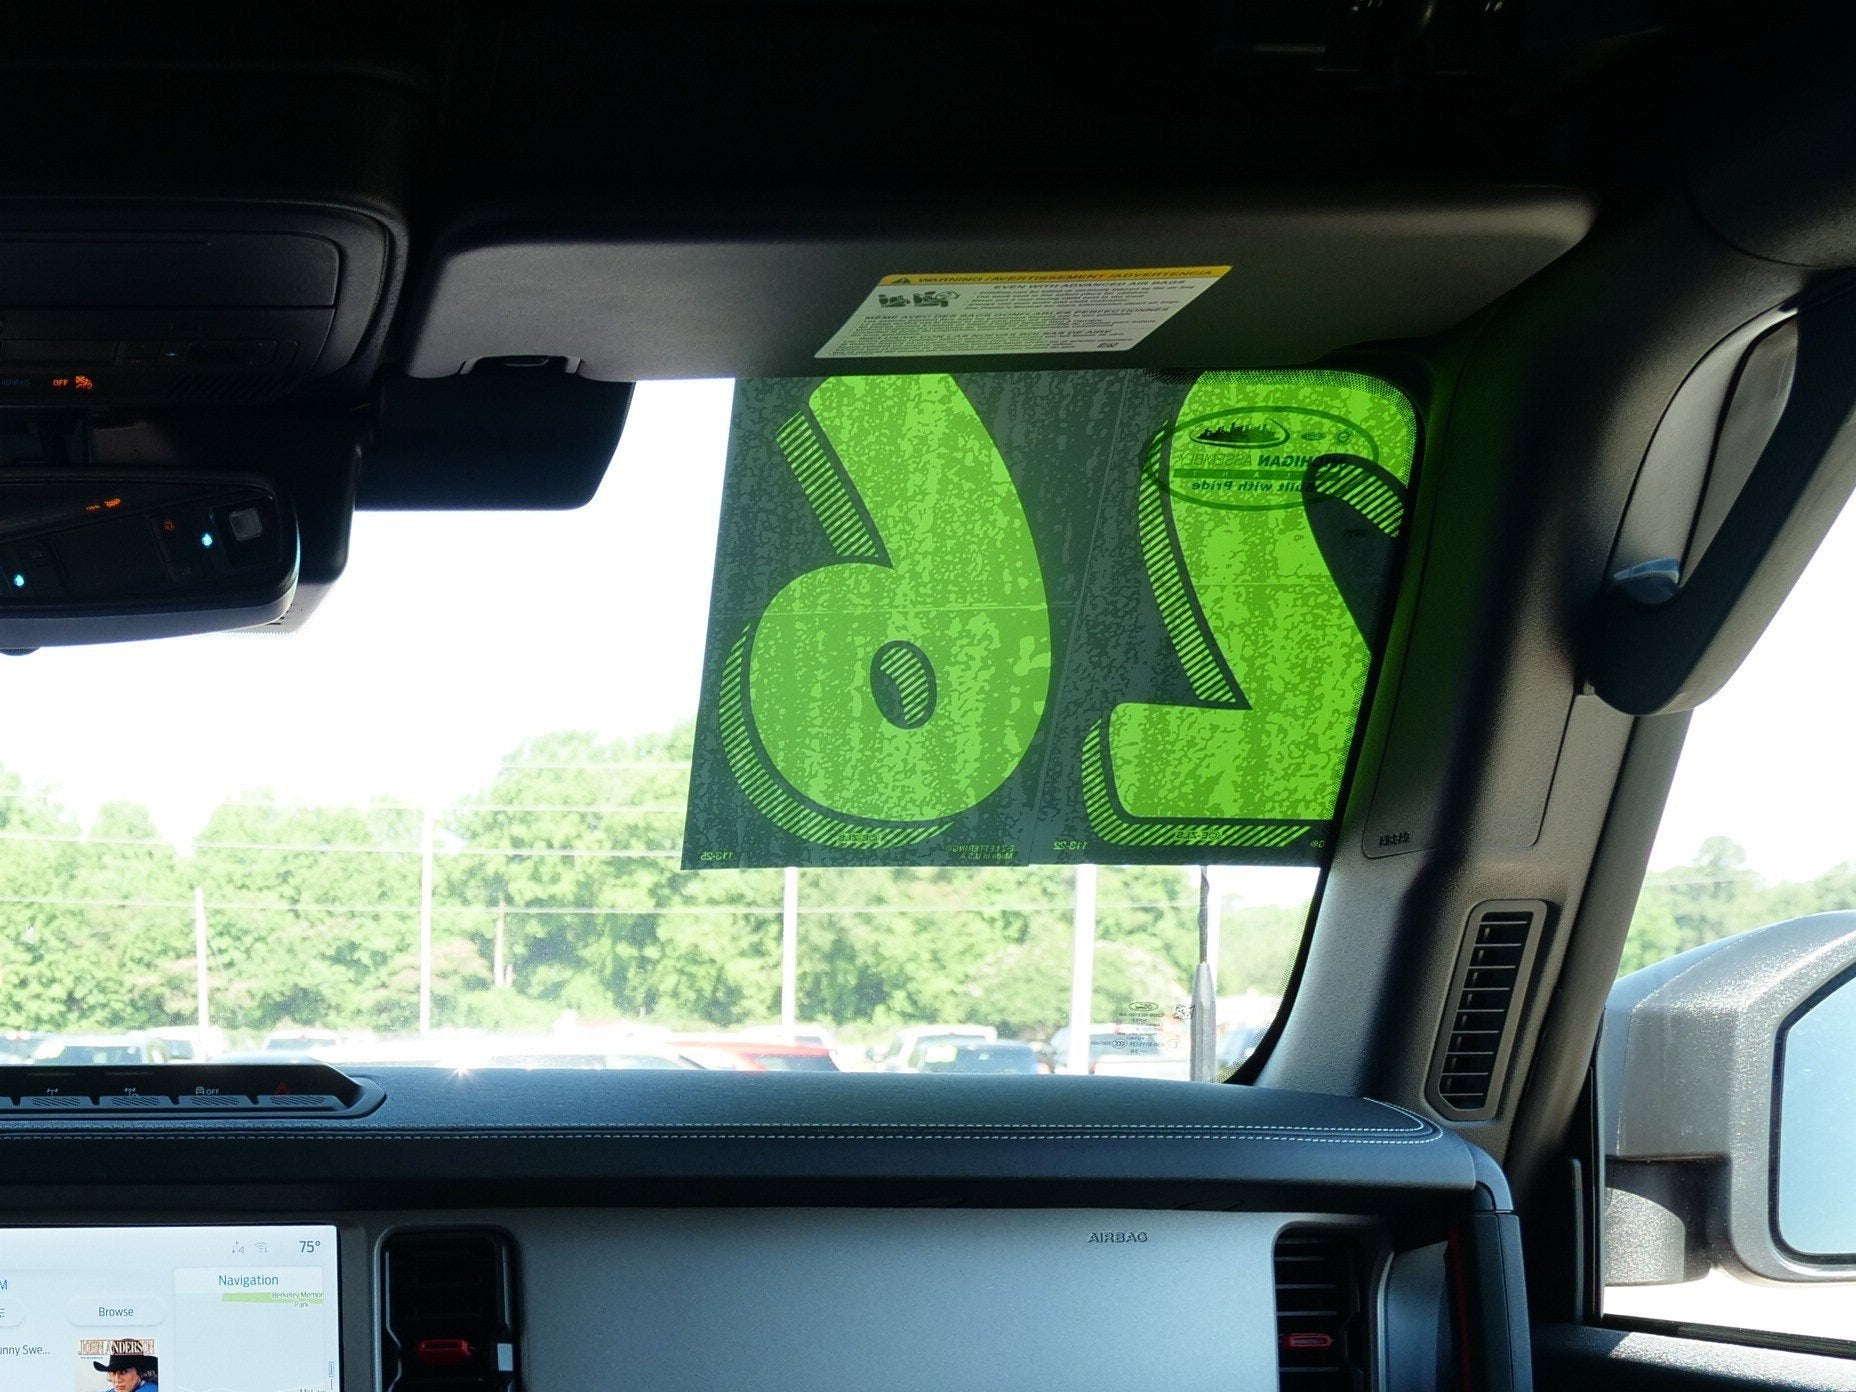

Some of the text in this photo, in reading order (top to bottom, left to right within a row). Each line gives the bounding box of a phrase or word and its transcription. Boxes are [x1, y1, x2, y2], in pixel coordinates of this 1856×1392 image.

[52, 379, 69, 387] OFF
[1088, 1231, 1148, 1244] AIRBAG
[299, 1240, 321, 1253] 75°
[218, 1275, 279, 1288] Navigation
[272, 1291, 300, 1300] Berkeley
[98, 1307, 134, 1317] Browse
